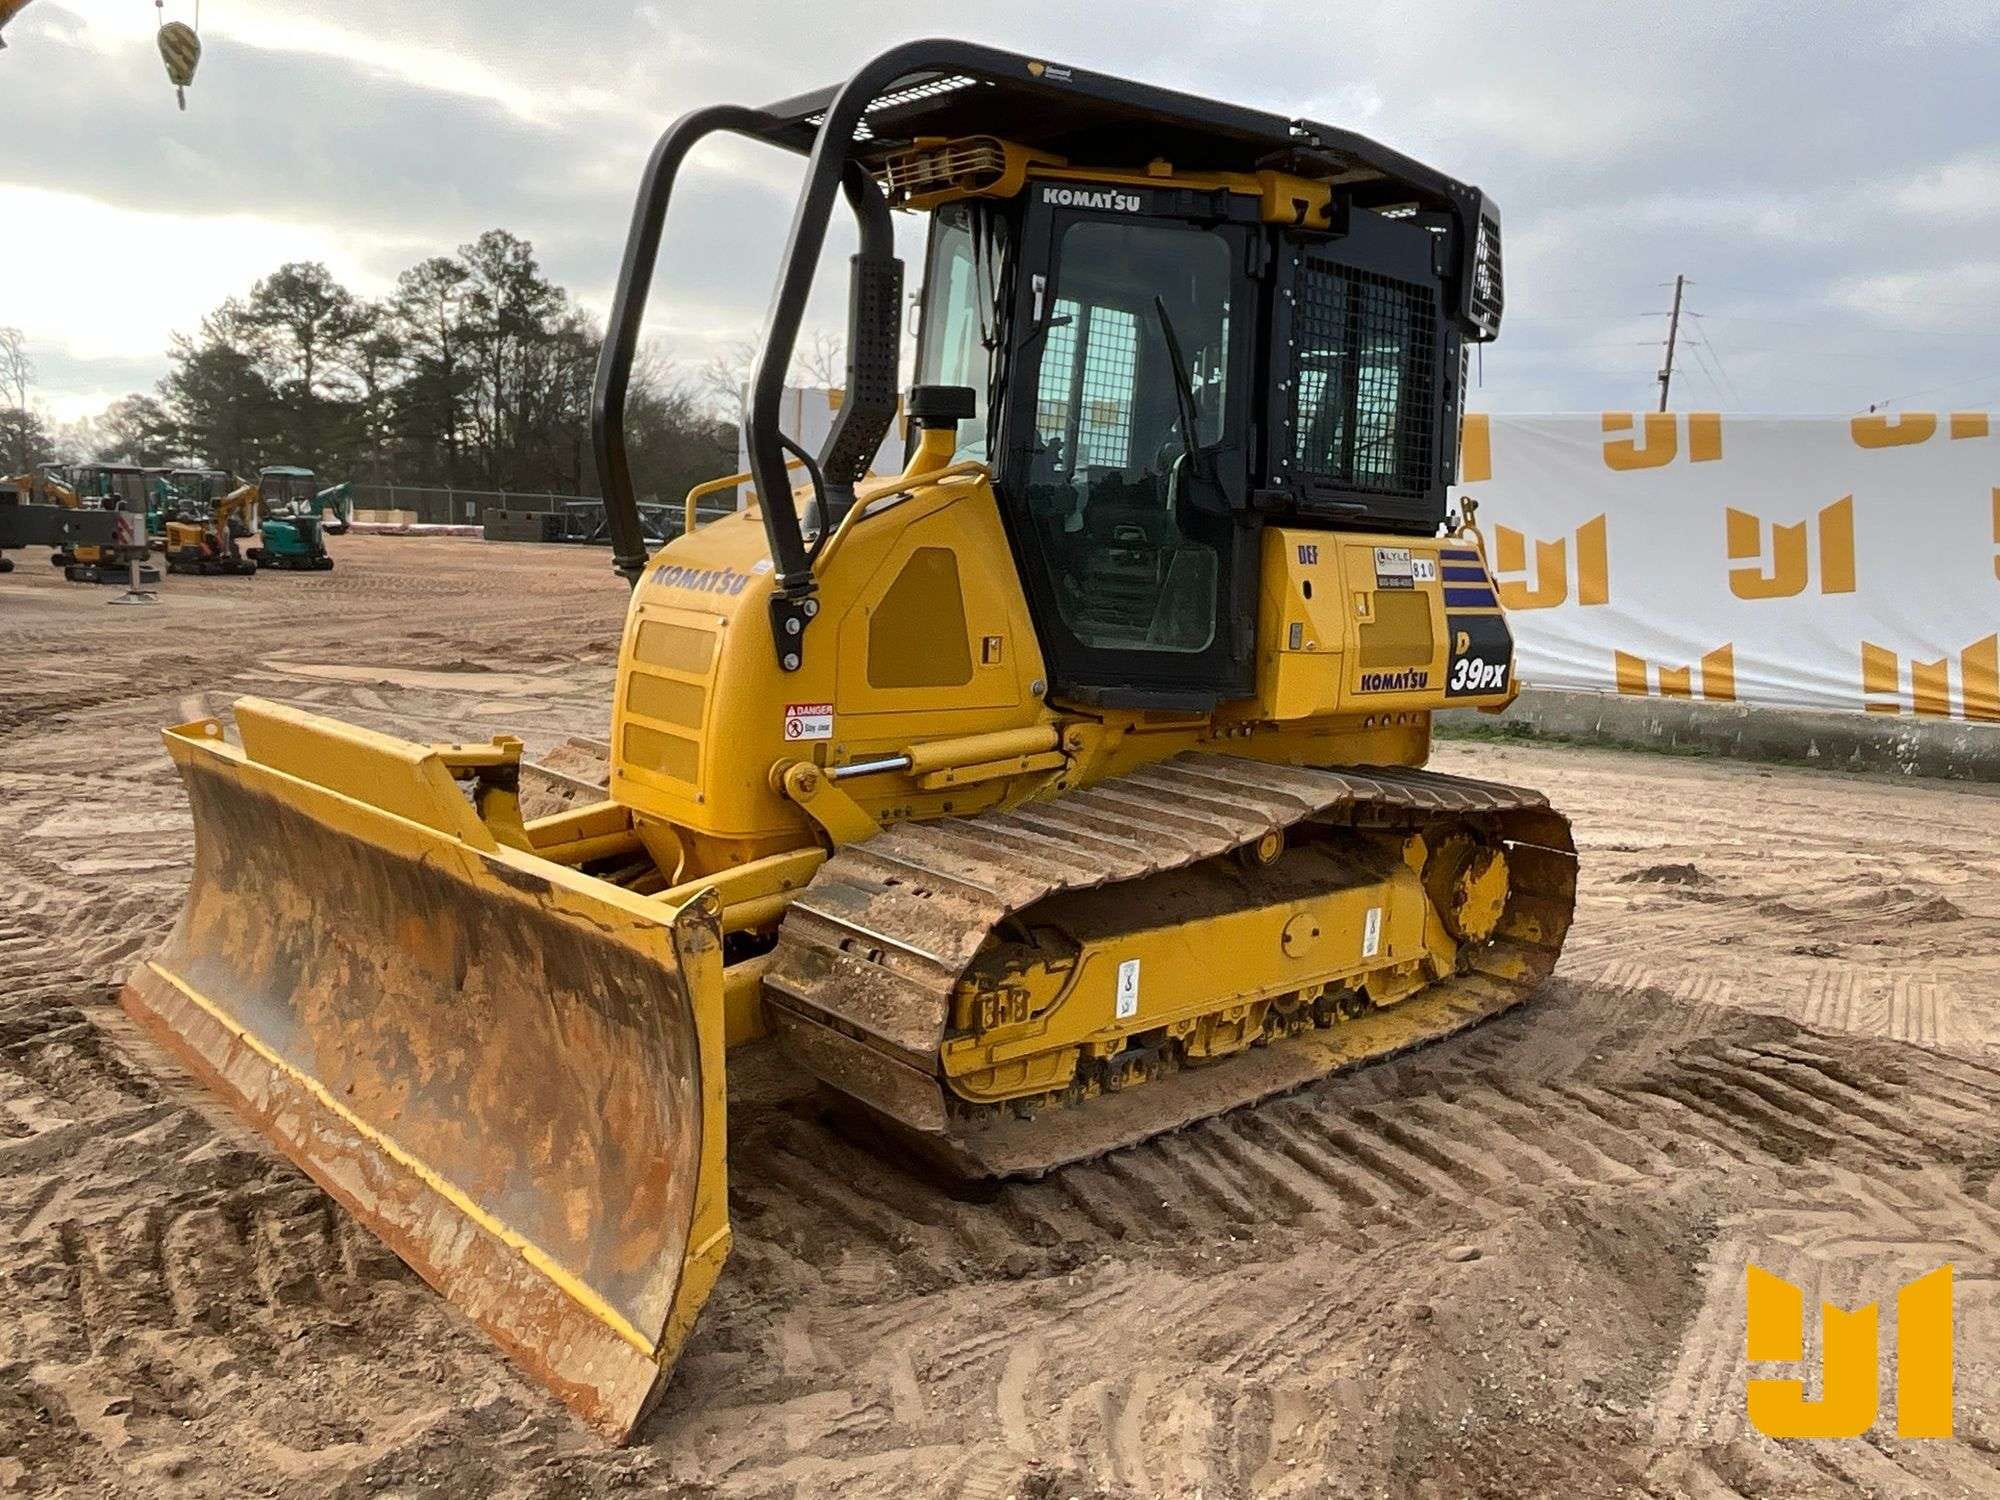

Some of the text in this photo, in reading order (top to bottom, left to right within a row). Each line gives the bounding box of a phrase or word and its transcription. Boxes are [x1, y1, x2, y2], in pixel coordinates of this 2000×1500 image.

[1043, 188, 1140, 212] KOMATSU
[650, 564, 750, 595] KOMATSU
[1413, 562, 1434, 577] 810
[1361, 667, 1428, 691] KOMATSU
[1450, 657, 1507, 691] 39PX
[796, 704, 833, 716] DANGER
